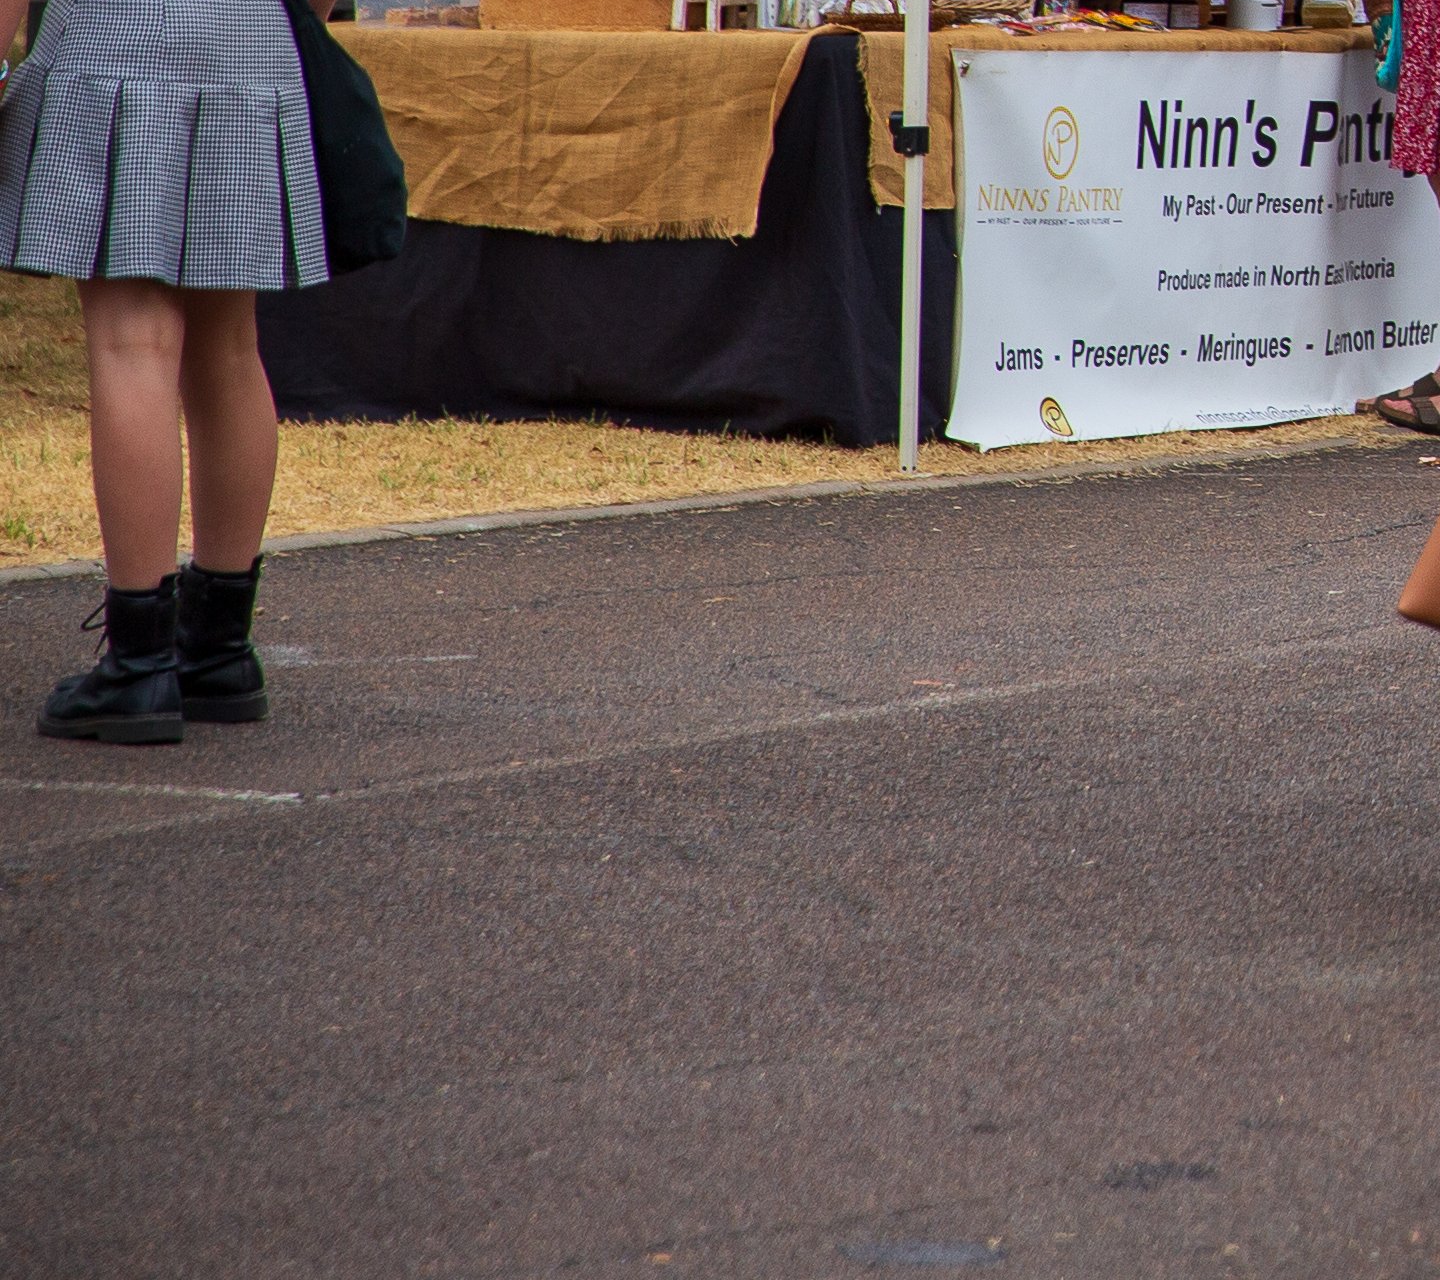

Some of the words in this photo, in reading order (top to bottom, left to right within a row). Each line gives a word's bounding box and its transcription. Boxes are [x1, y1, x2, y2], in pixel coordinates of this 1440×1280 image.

[1137, 99, 1279, 169] Ninn's
[977, 184, 1051, 212] NINNS
[1056, 185, 1124, 213] PANTRY
[1163, 194, 1183, 222] My
[1186, 193, 1216, 216] Past
[1226, 192, 1253, 214] Our
[1256, 192, 1325, 214] Present
[1350, 188, 1395, 210] Future
[1158, 268, 1211, 291] Produce
[1214, 265, 1250, 288] made
[1253, 266, 1266, 286] in
[1270, 264, 1320, 286] North
[995, 340, 1043, 371] Jams
[1071, 337, 1170, 368] Preserves
[1197, 333, 1292, 367] Meringues
[1324, 327, 1375, 356] Lemon
[1381, 319, 1438, 349] Butter
